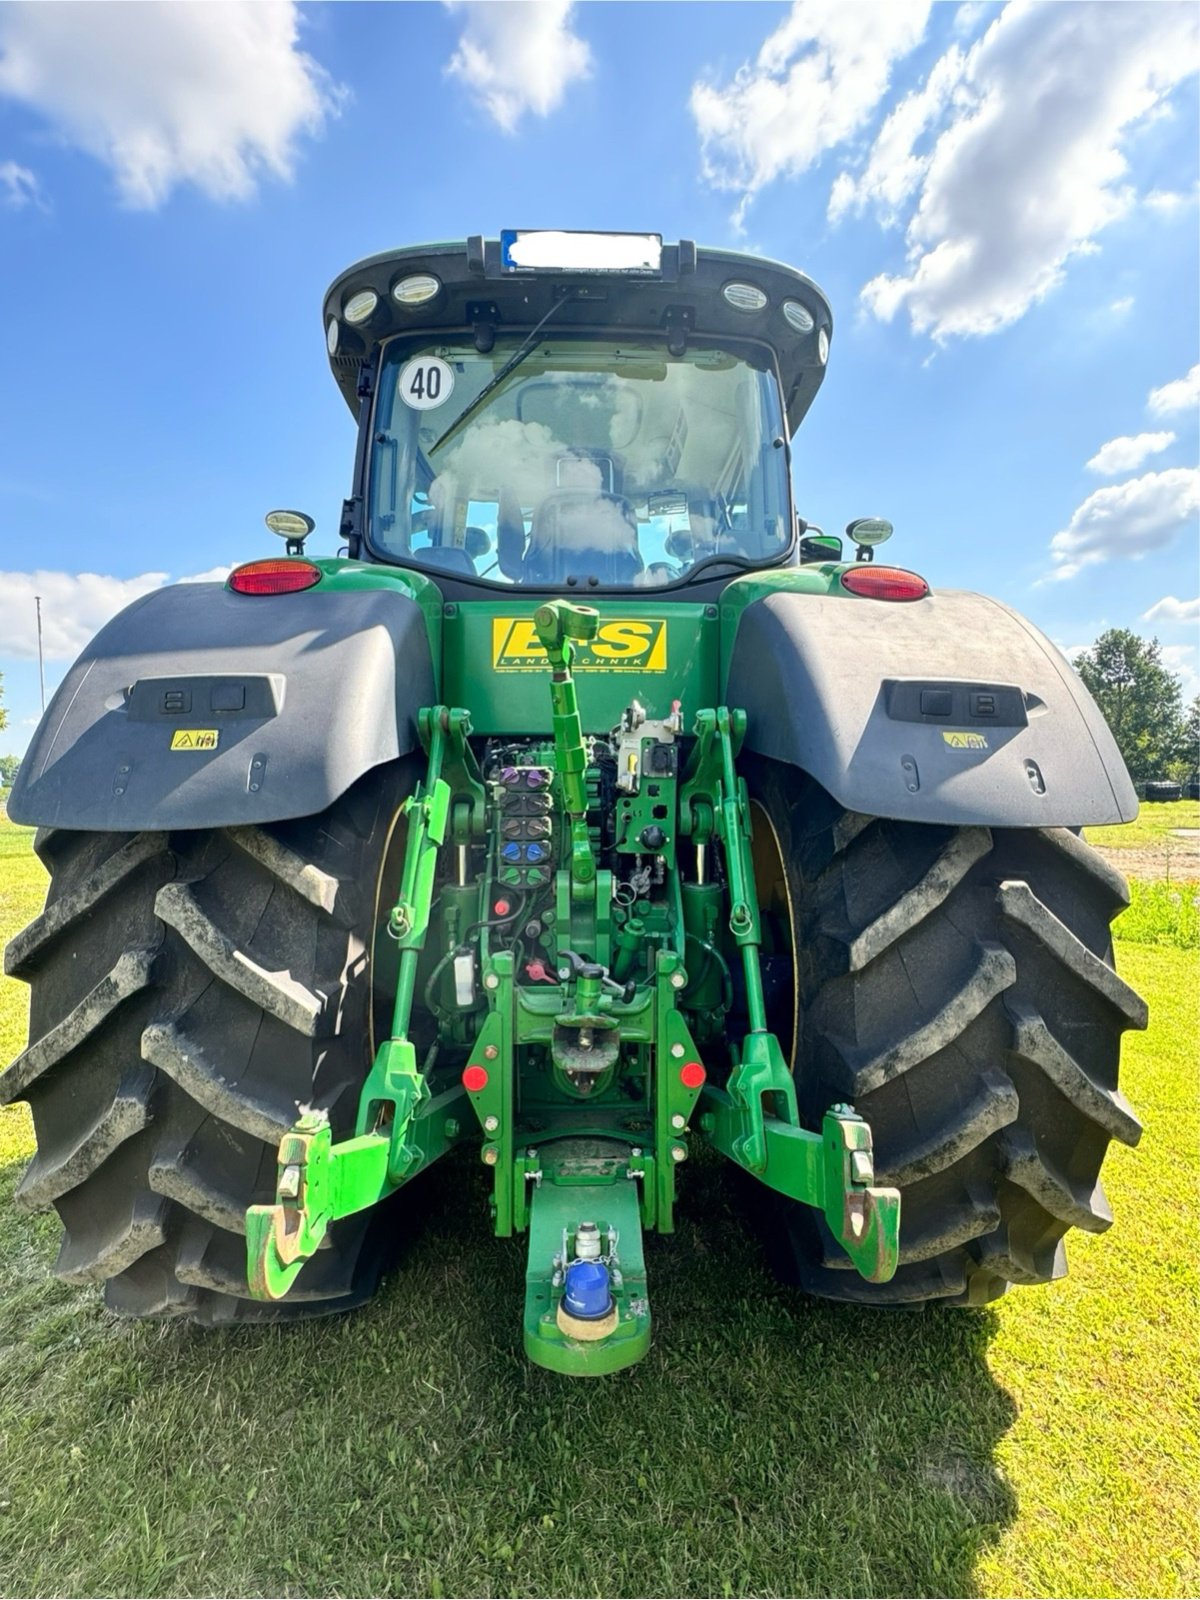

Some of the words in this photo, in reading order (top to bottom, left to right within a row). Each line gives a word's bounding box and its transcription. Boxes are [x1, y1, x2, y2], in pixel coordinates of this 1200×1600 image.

[410, 366, 441, 399] 40
[503, 622, 653, 658] ES
[500, 658, 642, 666] LANDCHNIK
